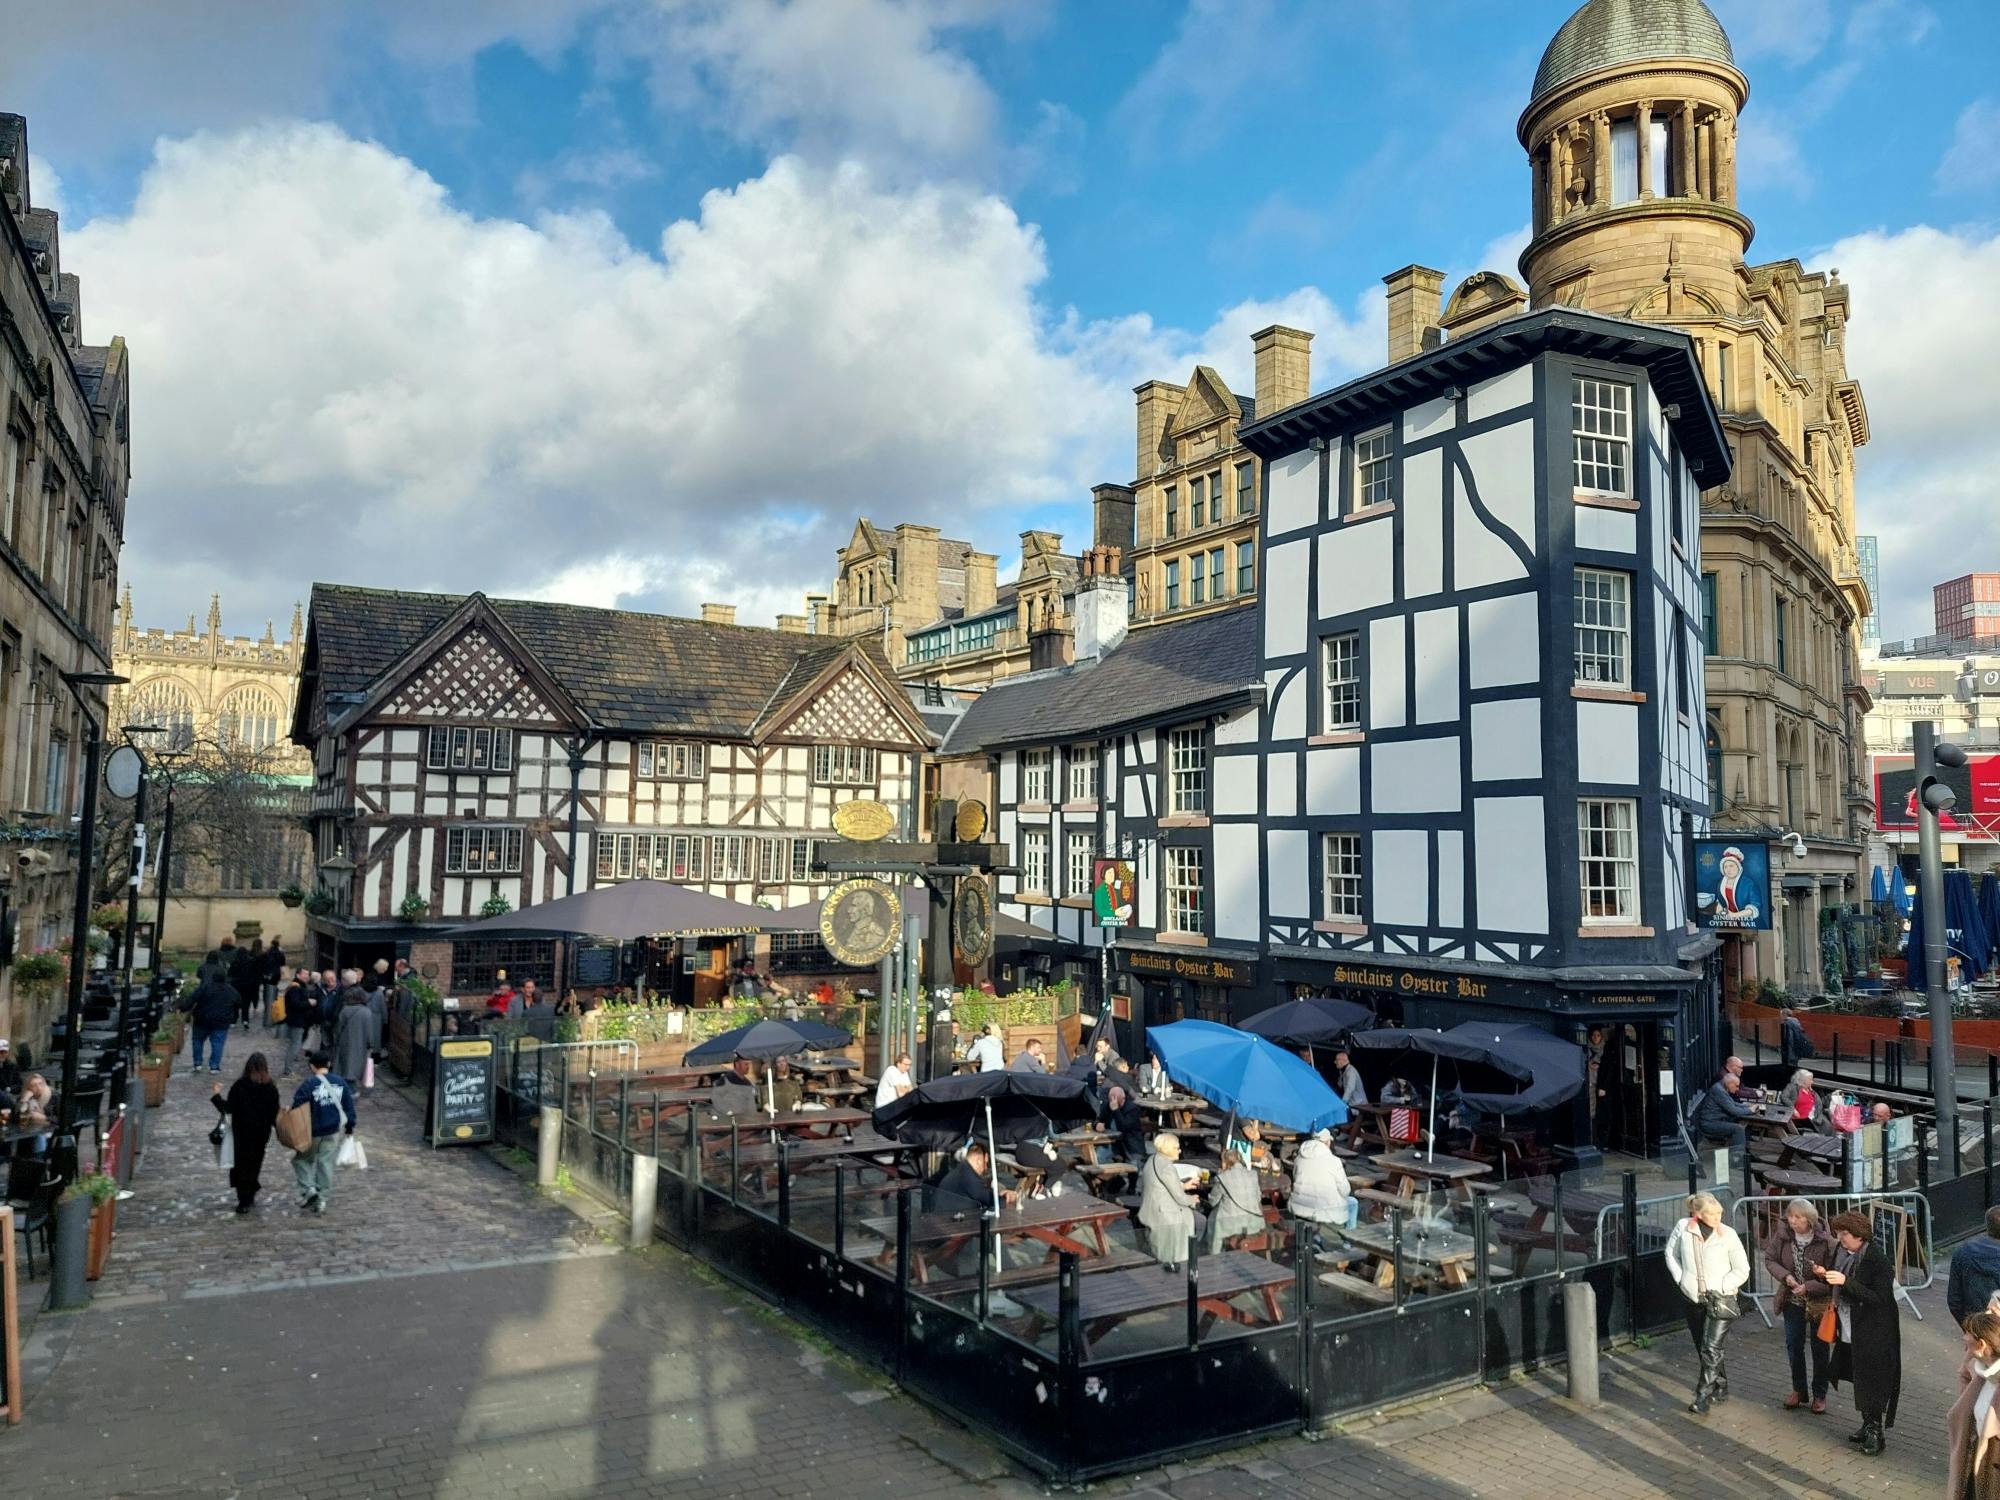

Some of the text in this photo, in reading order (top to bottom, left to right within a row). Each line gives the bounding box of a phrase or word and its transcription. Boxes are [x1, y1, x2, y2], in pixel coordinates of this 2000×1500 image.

[849, 879, 876, 890] THE
[821, 920, 836, 946] OLD
[1709, 920, 1738, 928] OYSTER
[837, 920, 901, 965] WELLINGTON
[1130, 953, 1234, 978] Sinclairs Oyster Bar
[1334, 966, 1488, 998] Sinclairs Oyster Bar
[1598, 996, 1635, 1004] CATHEDRAL
[1636, 995, 1656, 1003] GATES
[444, 1093, 475, 1106] PARTY
